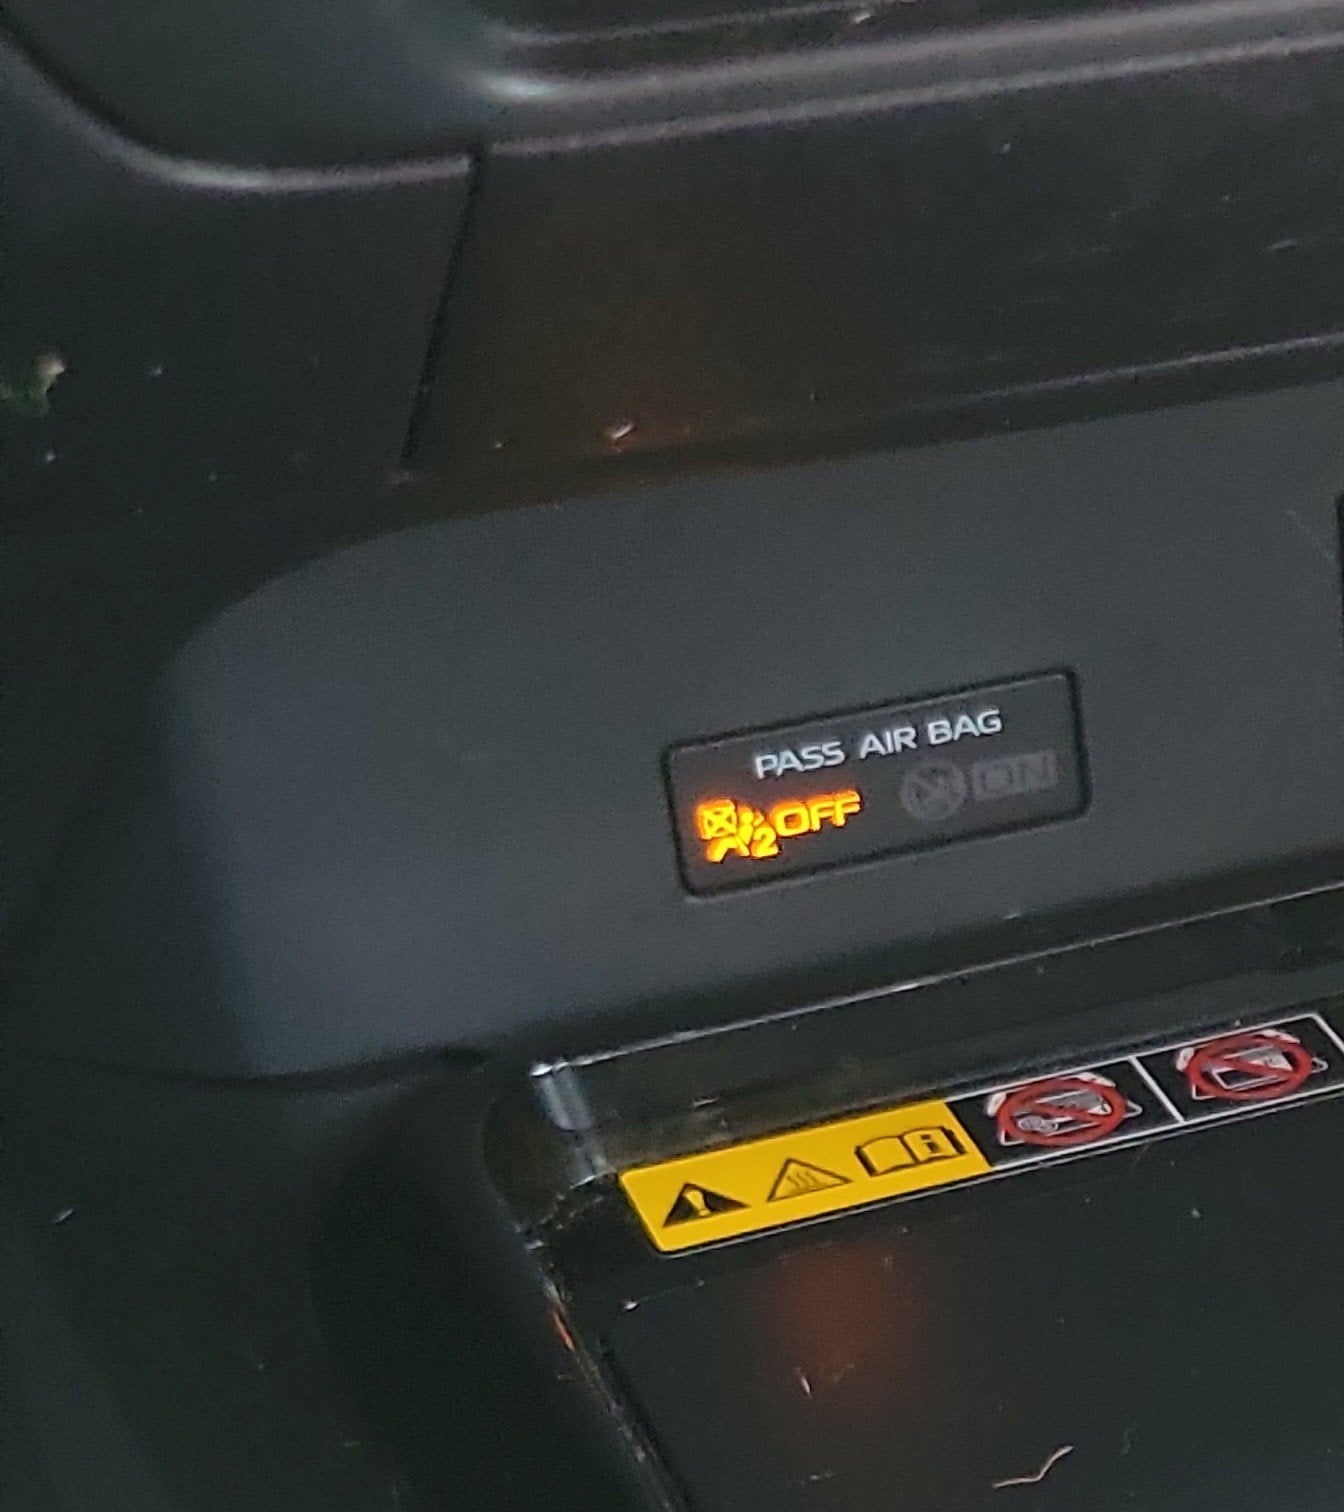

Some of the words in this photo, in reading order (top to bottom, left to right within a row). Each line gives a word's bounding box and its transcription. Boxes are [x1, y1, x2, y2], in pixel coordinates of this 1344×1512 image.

[754, 740, 845, 780] PASS
[859, 726, 918, 760] AIR
[926, 709, 1003, 746] BAG
[773, 790, 860, 837] OFF
